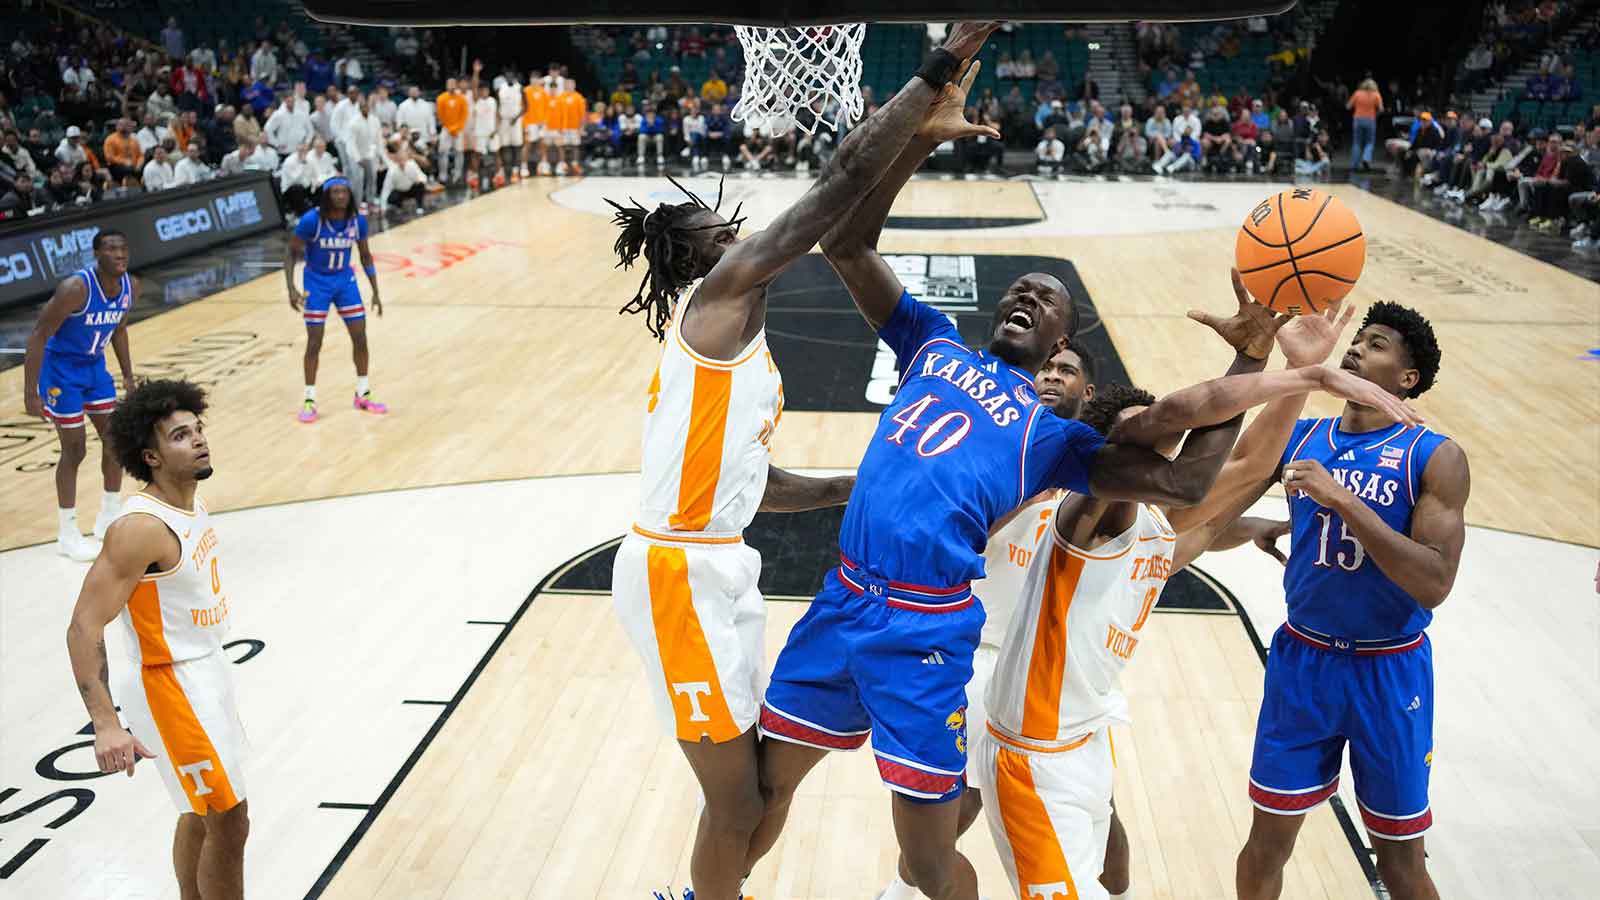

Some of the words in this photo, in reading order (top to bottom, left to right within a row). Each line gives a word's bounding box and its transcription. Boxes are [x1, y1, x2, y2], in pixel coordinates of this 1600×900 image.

[155, 208, 212, 241] GEICO
[327, 250, 345, 270] 11
[920, 352, 1021, 427] KANSAS
[887, 392, 973, 458] 40
[1298, 468, 1399, 507] NSAS
[1313, 511, 1365, 571] 15
[210, 557, 221, 595] 0
[672, 681, 712, 723] T
[178, 759, 215, 797] T
